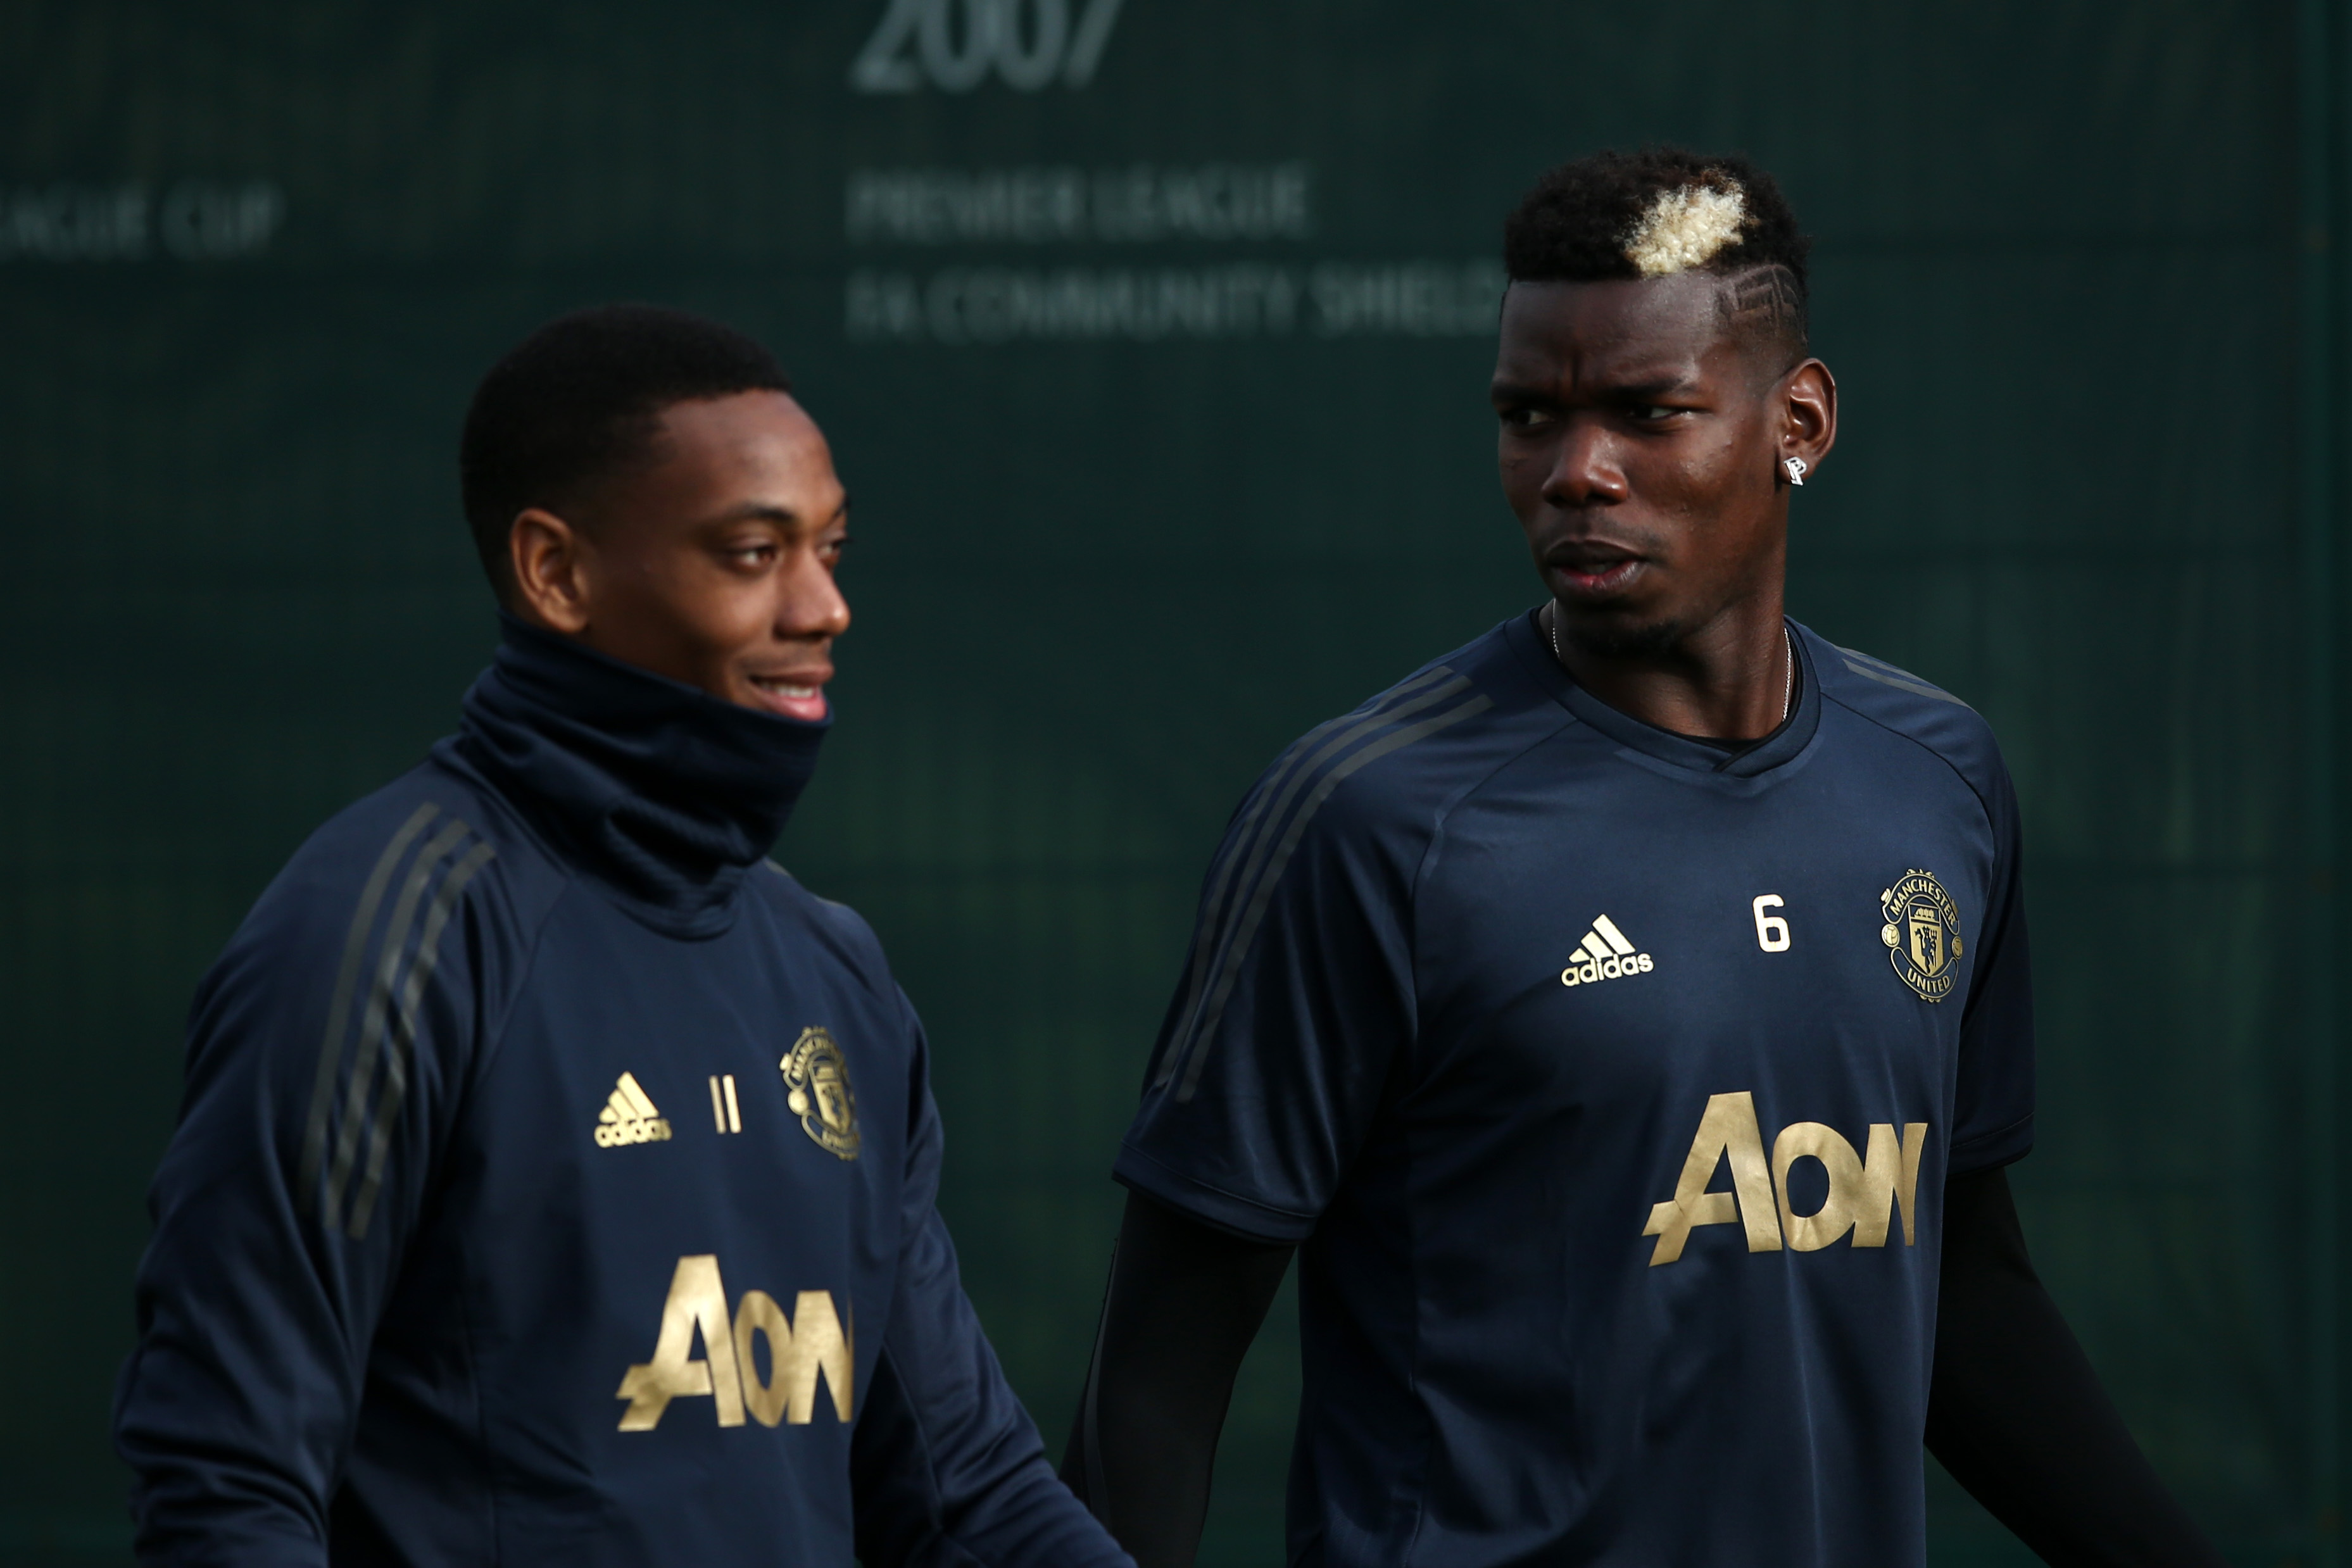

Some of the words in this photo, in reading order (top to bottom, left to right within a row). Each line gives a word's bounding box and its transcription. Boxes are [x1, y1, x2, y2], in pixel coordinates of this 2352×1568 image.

[0, 182, 151, 260] AGUE
[846, 168, 1084, 243] PREMIER
[1092, 162, 1308, 241] LEAGUE
[925, 263, 1295, 343] COMMUNITY
[1752, 894, 1791, 952] 6
[1890, 879, 1958, 926] MANCHESTER
[1561, 953, 1654, 987] adidas
[1907, 967, 1950, 993] UNITED
[594, 1118, 672, 1148] adidas
